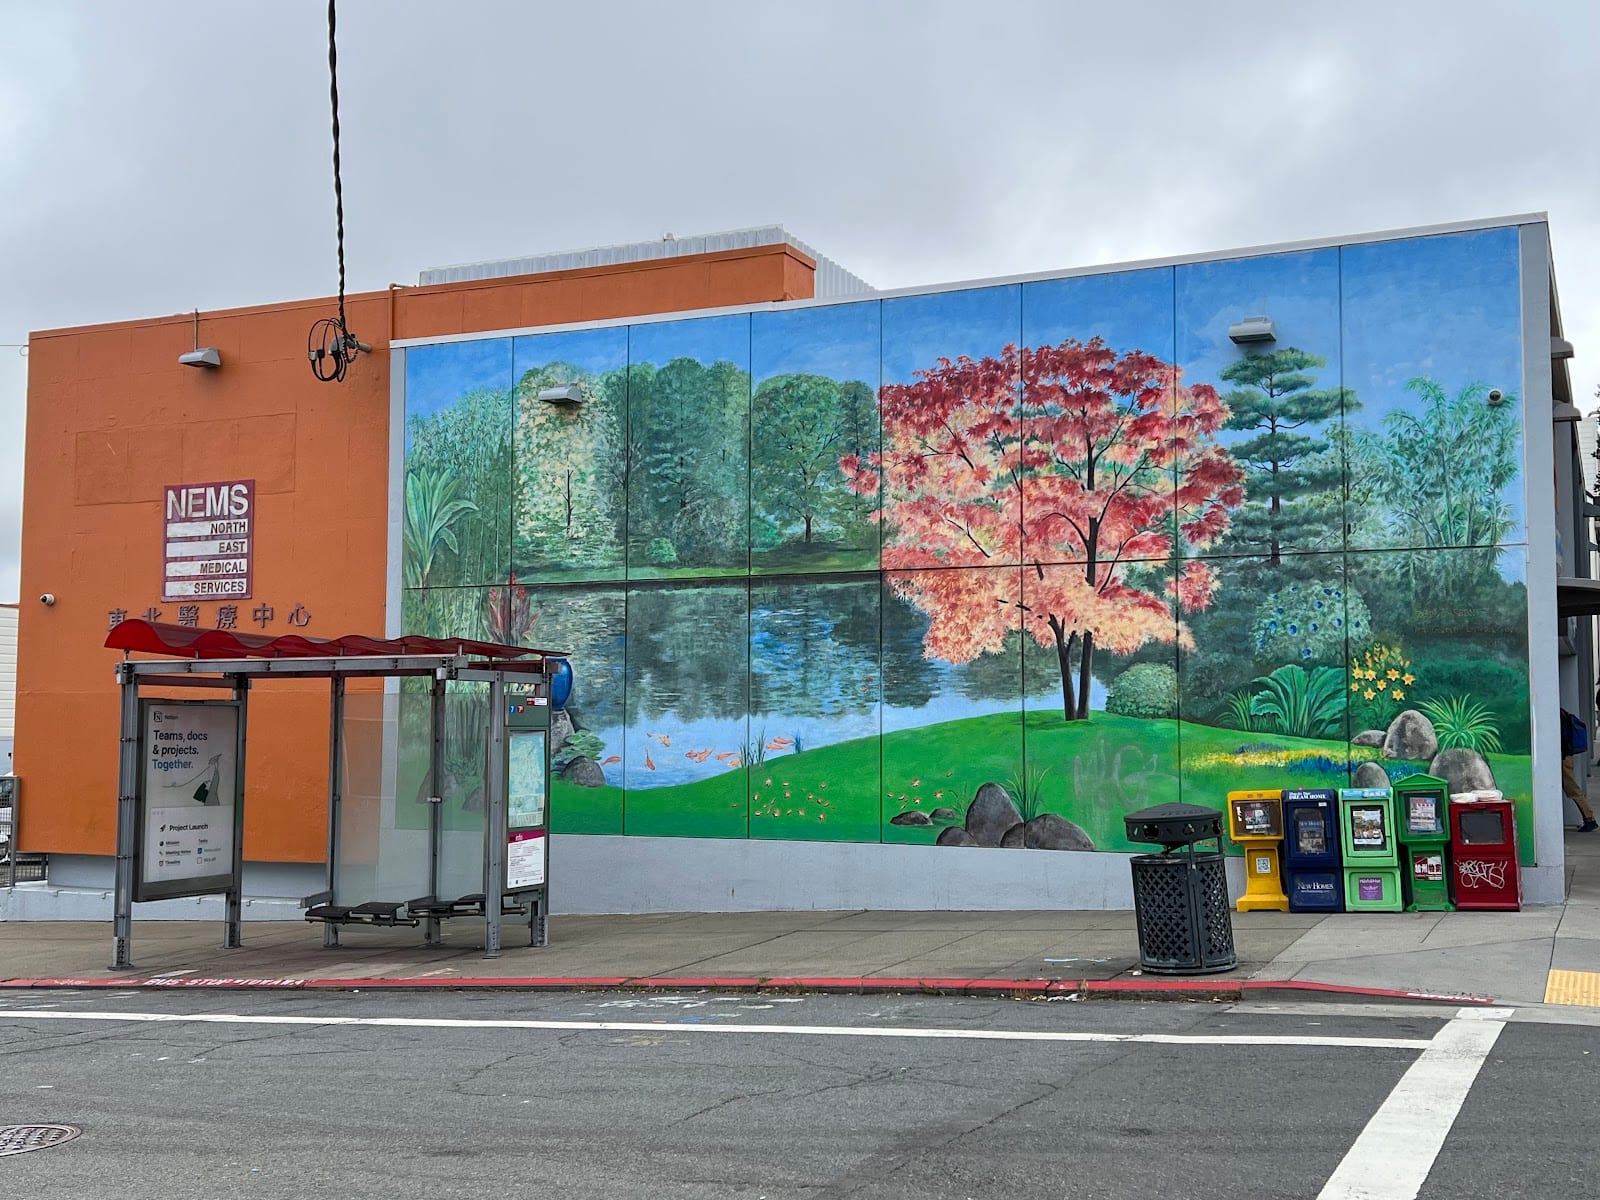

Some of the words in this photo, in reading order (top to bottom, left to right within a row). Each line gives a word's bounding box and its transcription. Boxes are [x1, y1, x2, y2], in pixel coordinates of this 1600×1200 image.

[167, 484, 248, 520] NEMS
[210, 521, 246, 535] NORTH
[218, 541, 246, 554] EAST
[200, 560, 245, 574] MEDICAL
[193, 581, 245, 594] SERVICES
[153, 730, 186, 742] Teams,
[187, 730, 208, 741] docs
[152, 744, 159, 755] &
[161, 744, 199, 757] projects.
[152, 759, 194, 771] Together.
[169, 824, 188, 832] Project
[189, 823, 209, 831] Launch
[143, 978, 184, 986] BUS
[185, 978, 233, 986] STOP
